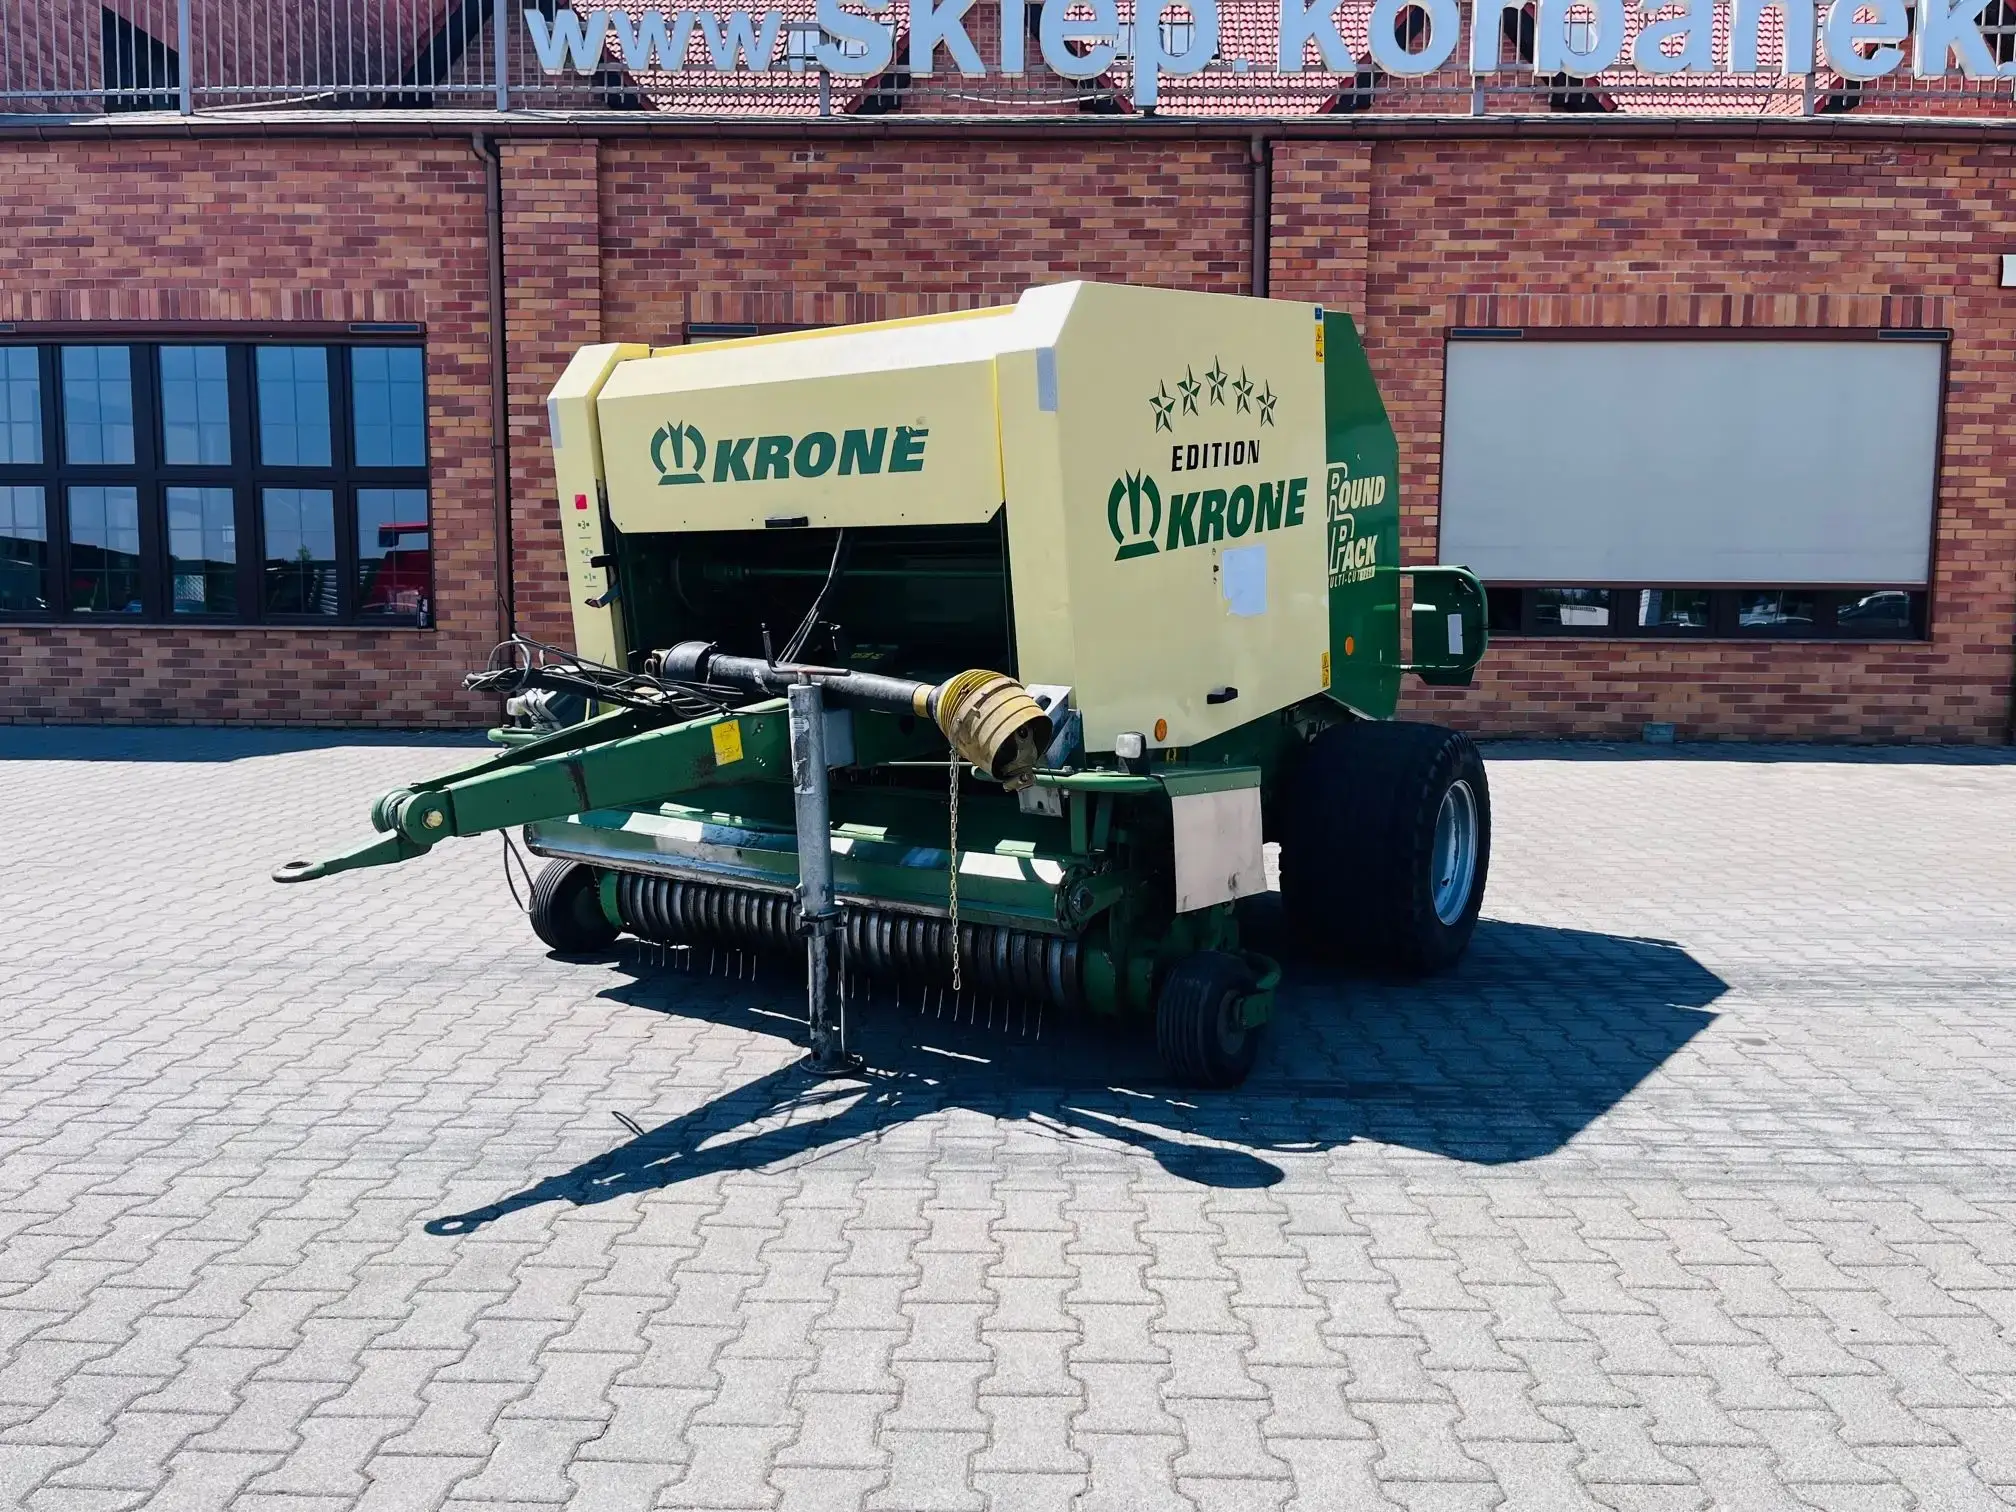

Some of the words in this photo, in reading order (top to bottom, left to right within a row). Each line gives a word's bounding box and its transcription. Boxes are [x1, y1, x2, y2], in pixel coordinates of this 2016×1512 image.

[712, 425, 929, 483] KRONE
[1171, 439, 1260, 472] EDITION
[1166, 477, 1308, 551] KRONE
[1327, 461, 1385, 522] ROUND
[1328, 513, 1378, 575] PACK
[1329, 569, 1360, 588] ULTI-CUT
